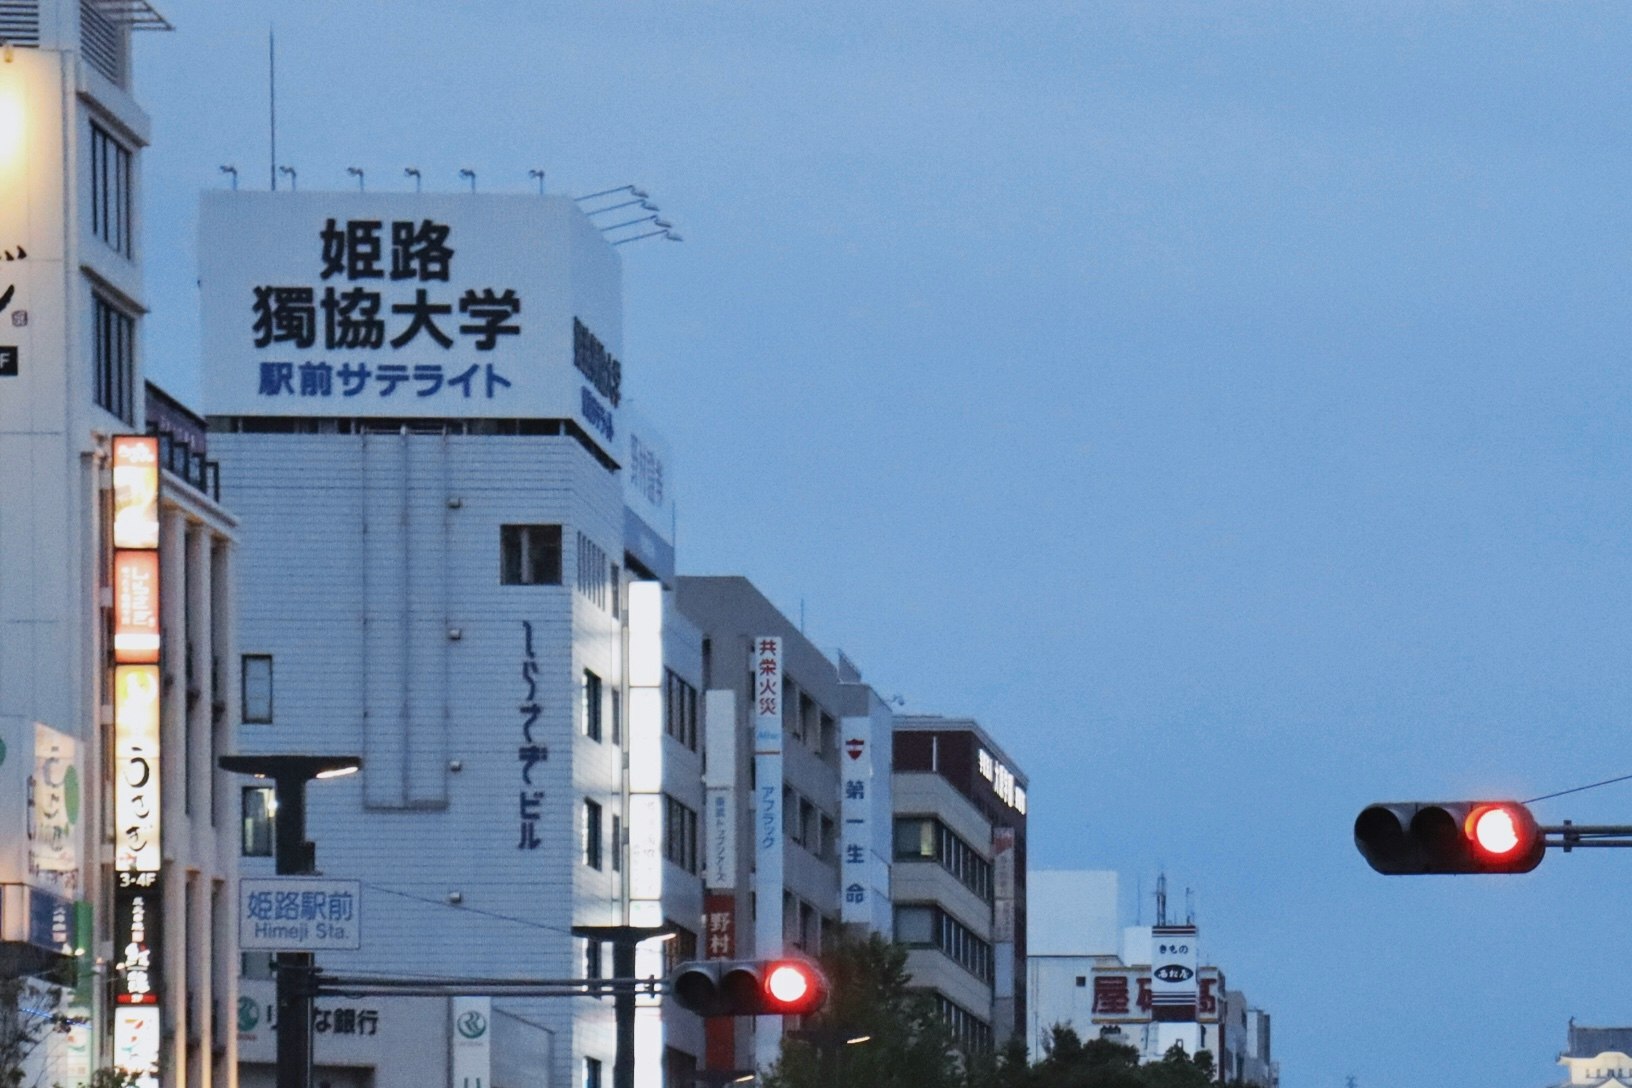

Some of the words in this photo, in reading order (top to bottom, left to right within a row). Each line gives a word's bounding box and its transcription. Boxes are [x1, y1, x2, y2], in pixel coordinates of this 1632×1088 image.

[319, 218, 455, 282] 姫路
[252, 286, 520, 350] 獨協大学
[258, 361, 511, 399] 駅前サテライト
[758, 639, 778, 716] 共栄火災
[518, 619, 549, 850] しらさぎビル
[760, 785, 775, 849] アフラック
[846, 780, 865, 903] 第一生命
[247, 891, 354, 922] 姫路駅前
[254, 923, 308, 942] Himeji
[316, 923, 349, 939] Sta.
[710, 912, 730, 960] 野村
[266, 1007, 379, 1036] りな銀行
